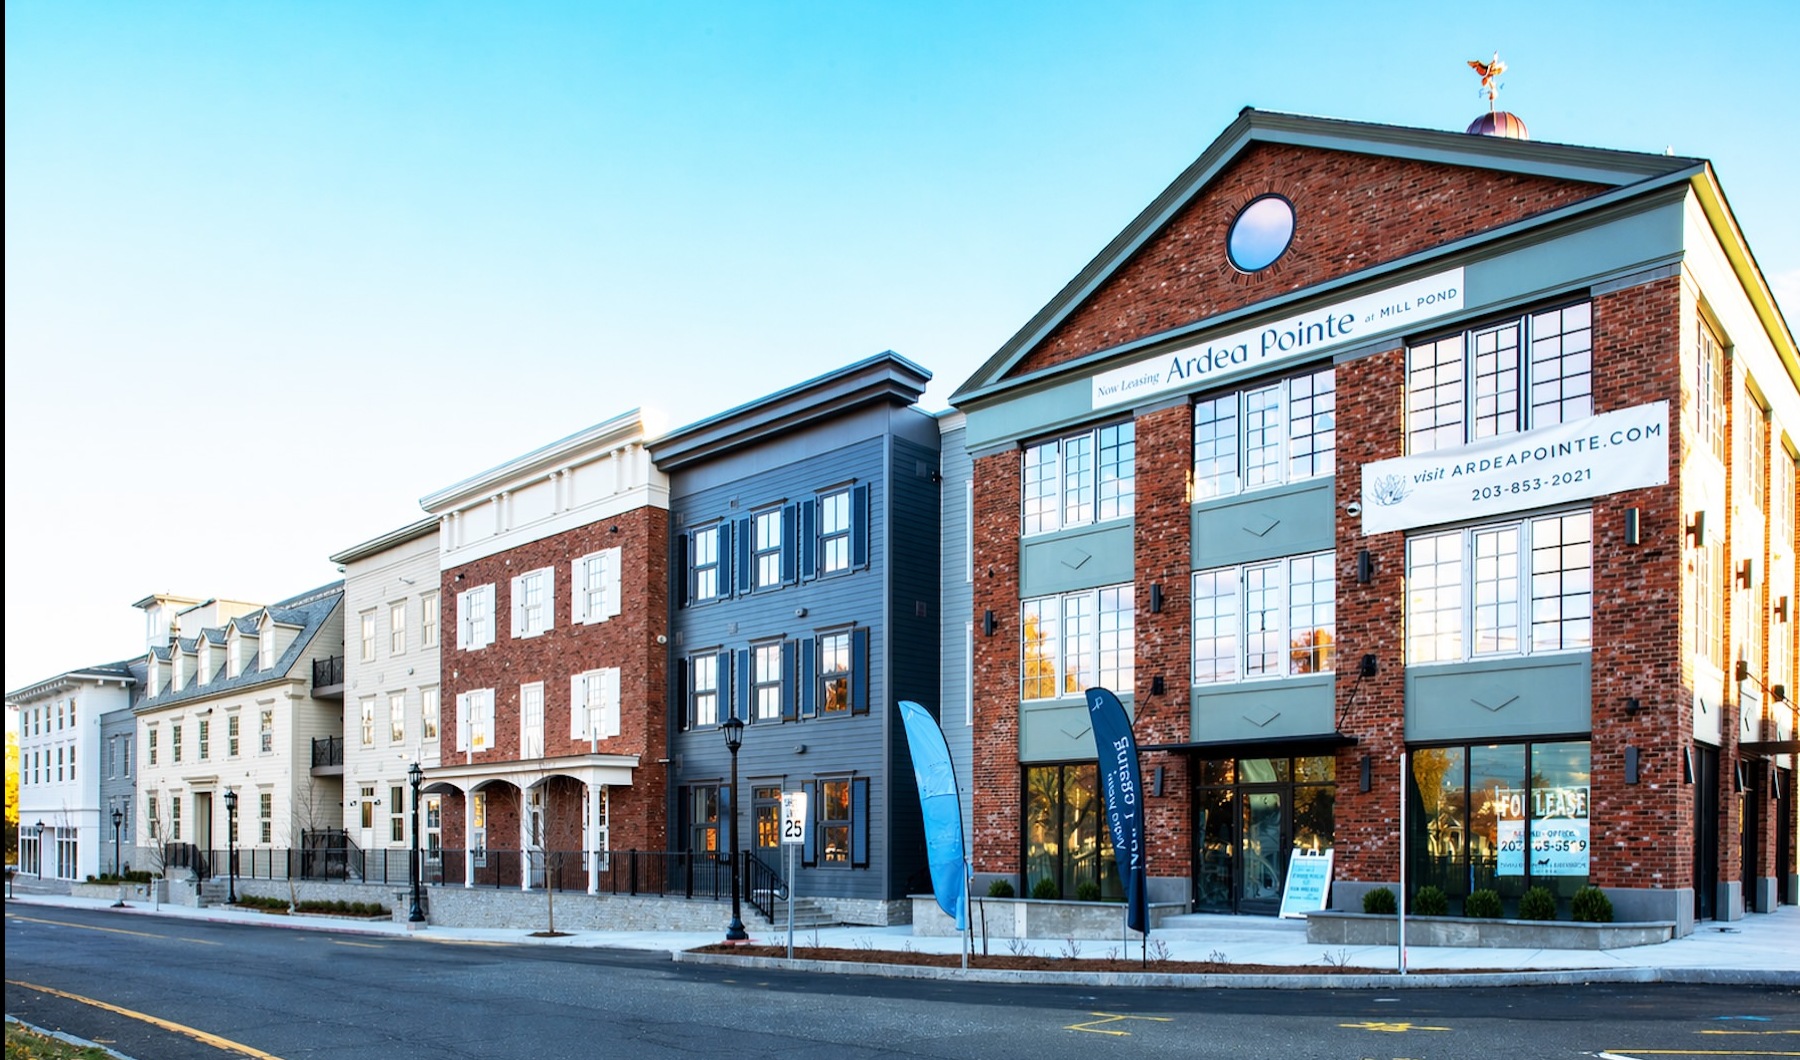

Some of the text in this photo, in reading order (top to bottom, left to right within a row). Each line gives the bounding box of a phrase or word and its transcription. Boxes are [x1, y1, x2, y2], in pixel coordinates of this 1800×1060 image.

[1098, 288, 1457, 397] Now Leasing Ardea Pointe at MILL POND
[1413, 422, 1661, 484] visit ARDEAPOINTE.COM
[1471, 468, 1592, 502] 203-853-2021
[1535, 792, 1587, 816] LEASE
[785, 819, 802, 838] 25
